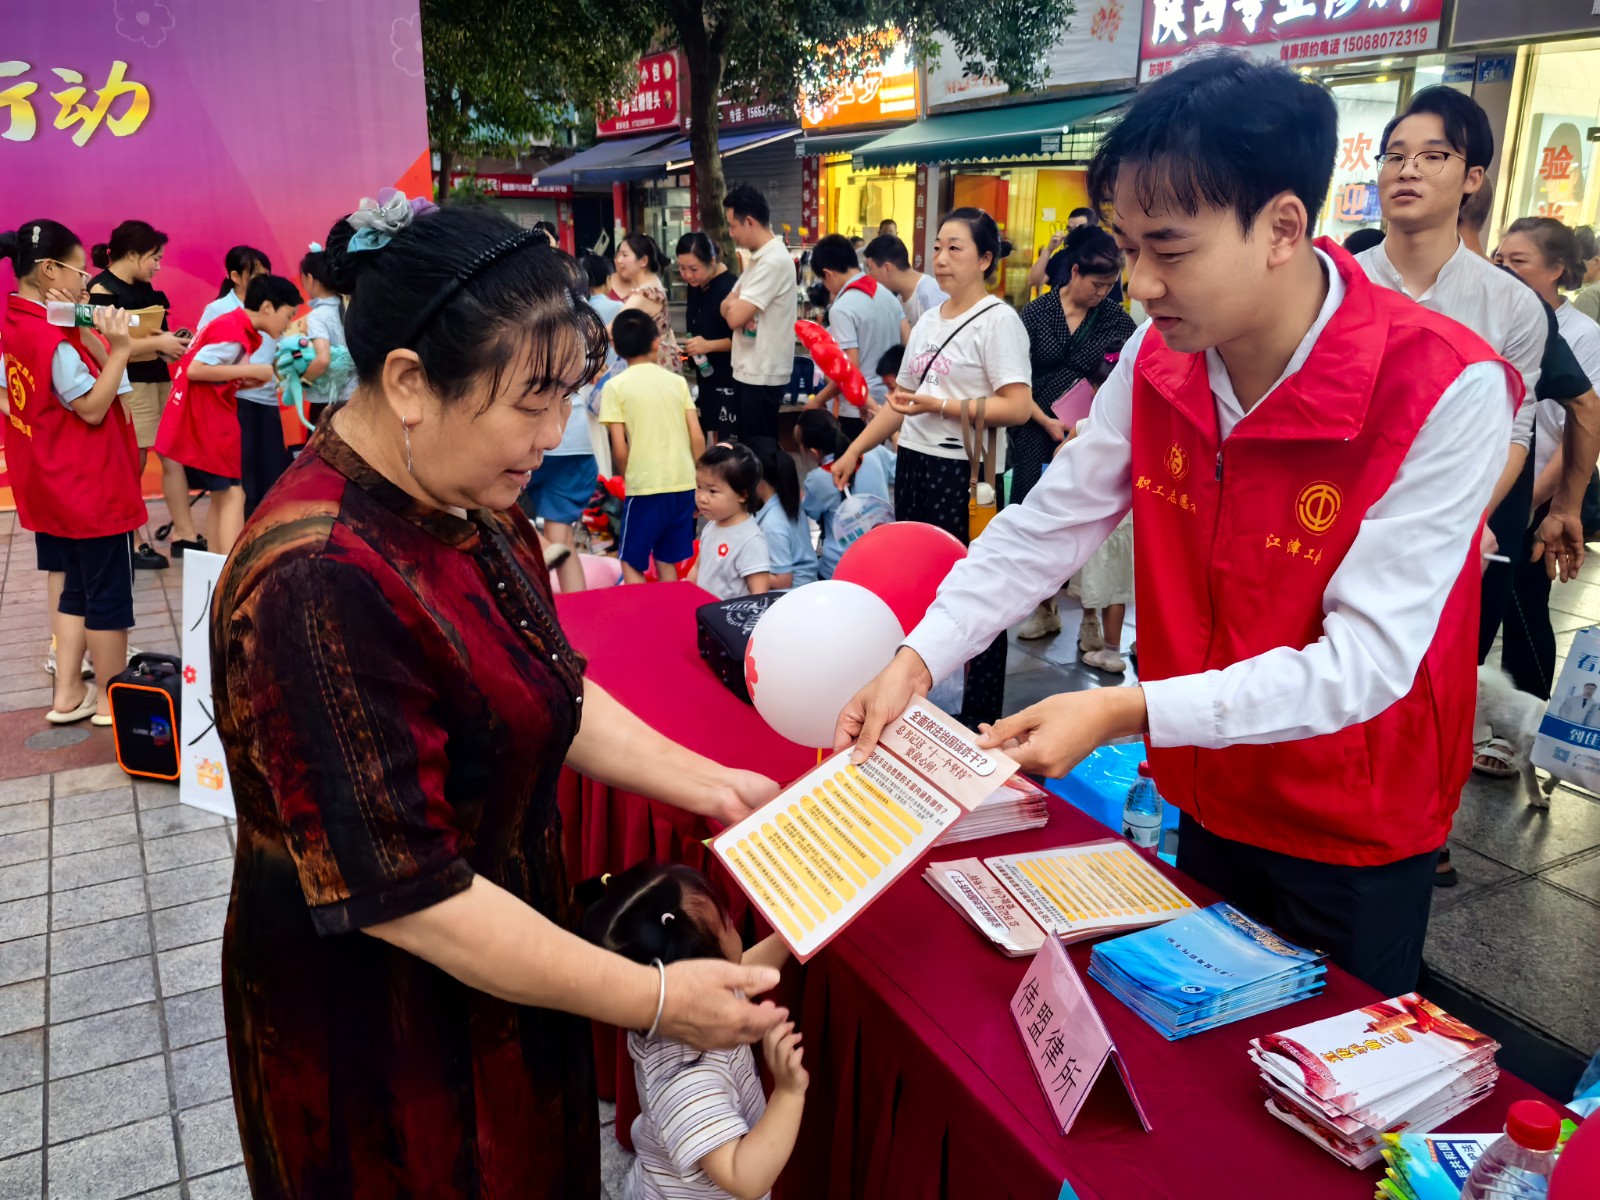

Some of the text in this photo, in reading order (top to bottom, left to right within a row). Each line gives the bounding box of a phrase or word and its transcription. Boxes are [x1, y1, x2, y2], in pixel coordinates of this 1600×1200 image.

[1152, 0, 1408, 45] 陕西专业
[1343, 27, 1428, 53] 15068072319
[1333, 132, 1373, 221] 欢迎
[1017, 976, 1082, 1106] 伟盟律所
